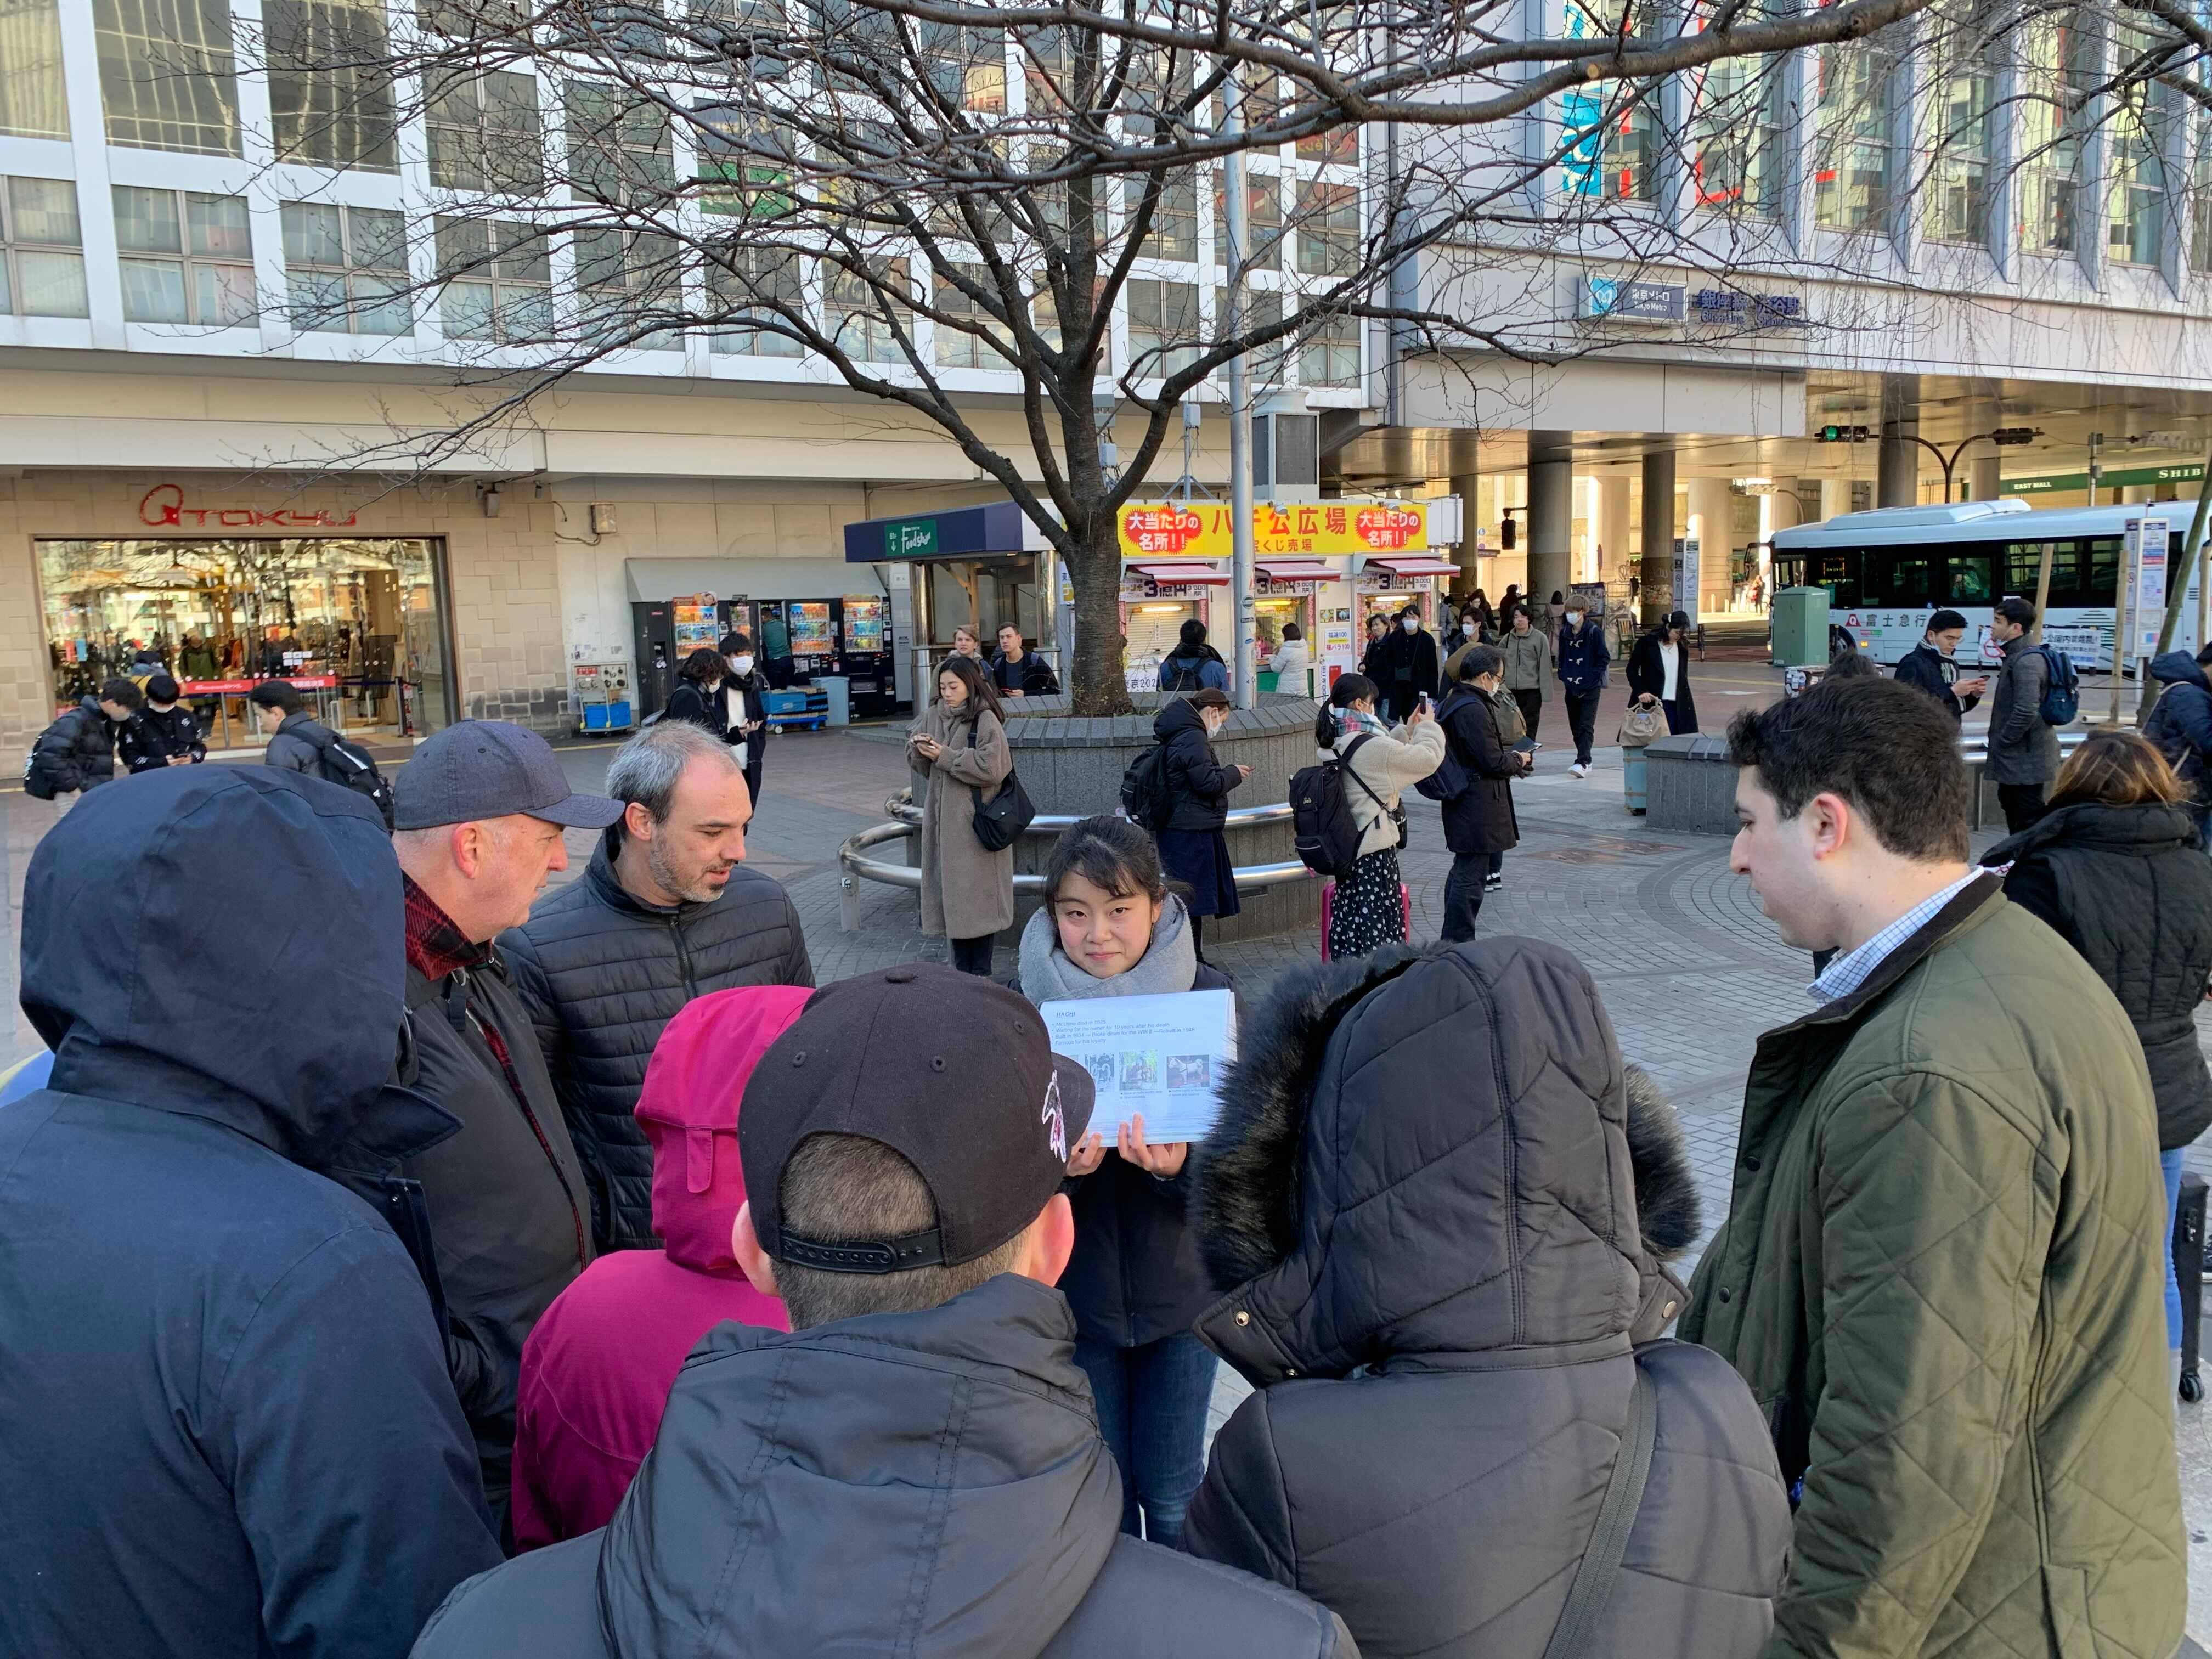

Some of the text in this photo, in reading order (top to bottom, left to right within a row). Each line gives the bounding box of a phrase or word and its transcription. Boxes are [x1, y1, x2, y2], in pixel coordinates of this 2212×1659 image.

[1632, 289, 1670, 302] 東京メトロ
[1634, 301, 1668, 312] Tokyo Metro
[2158, 468, 2207, 479] SHIB
[1128, 513, 1199, 531] 大当たりの
[1359, 510, 1419, 528] 大当たりの
[1866, 614, 1927, 627] 富士急行
